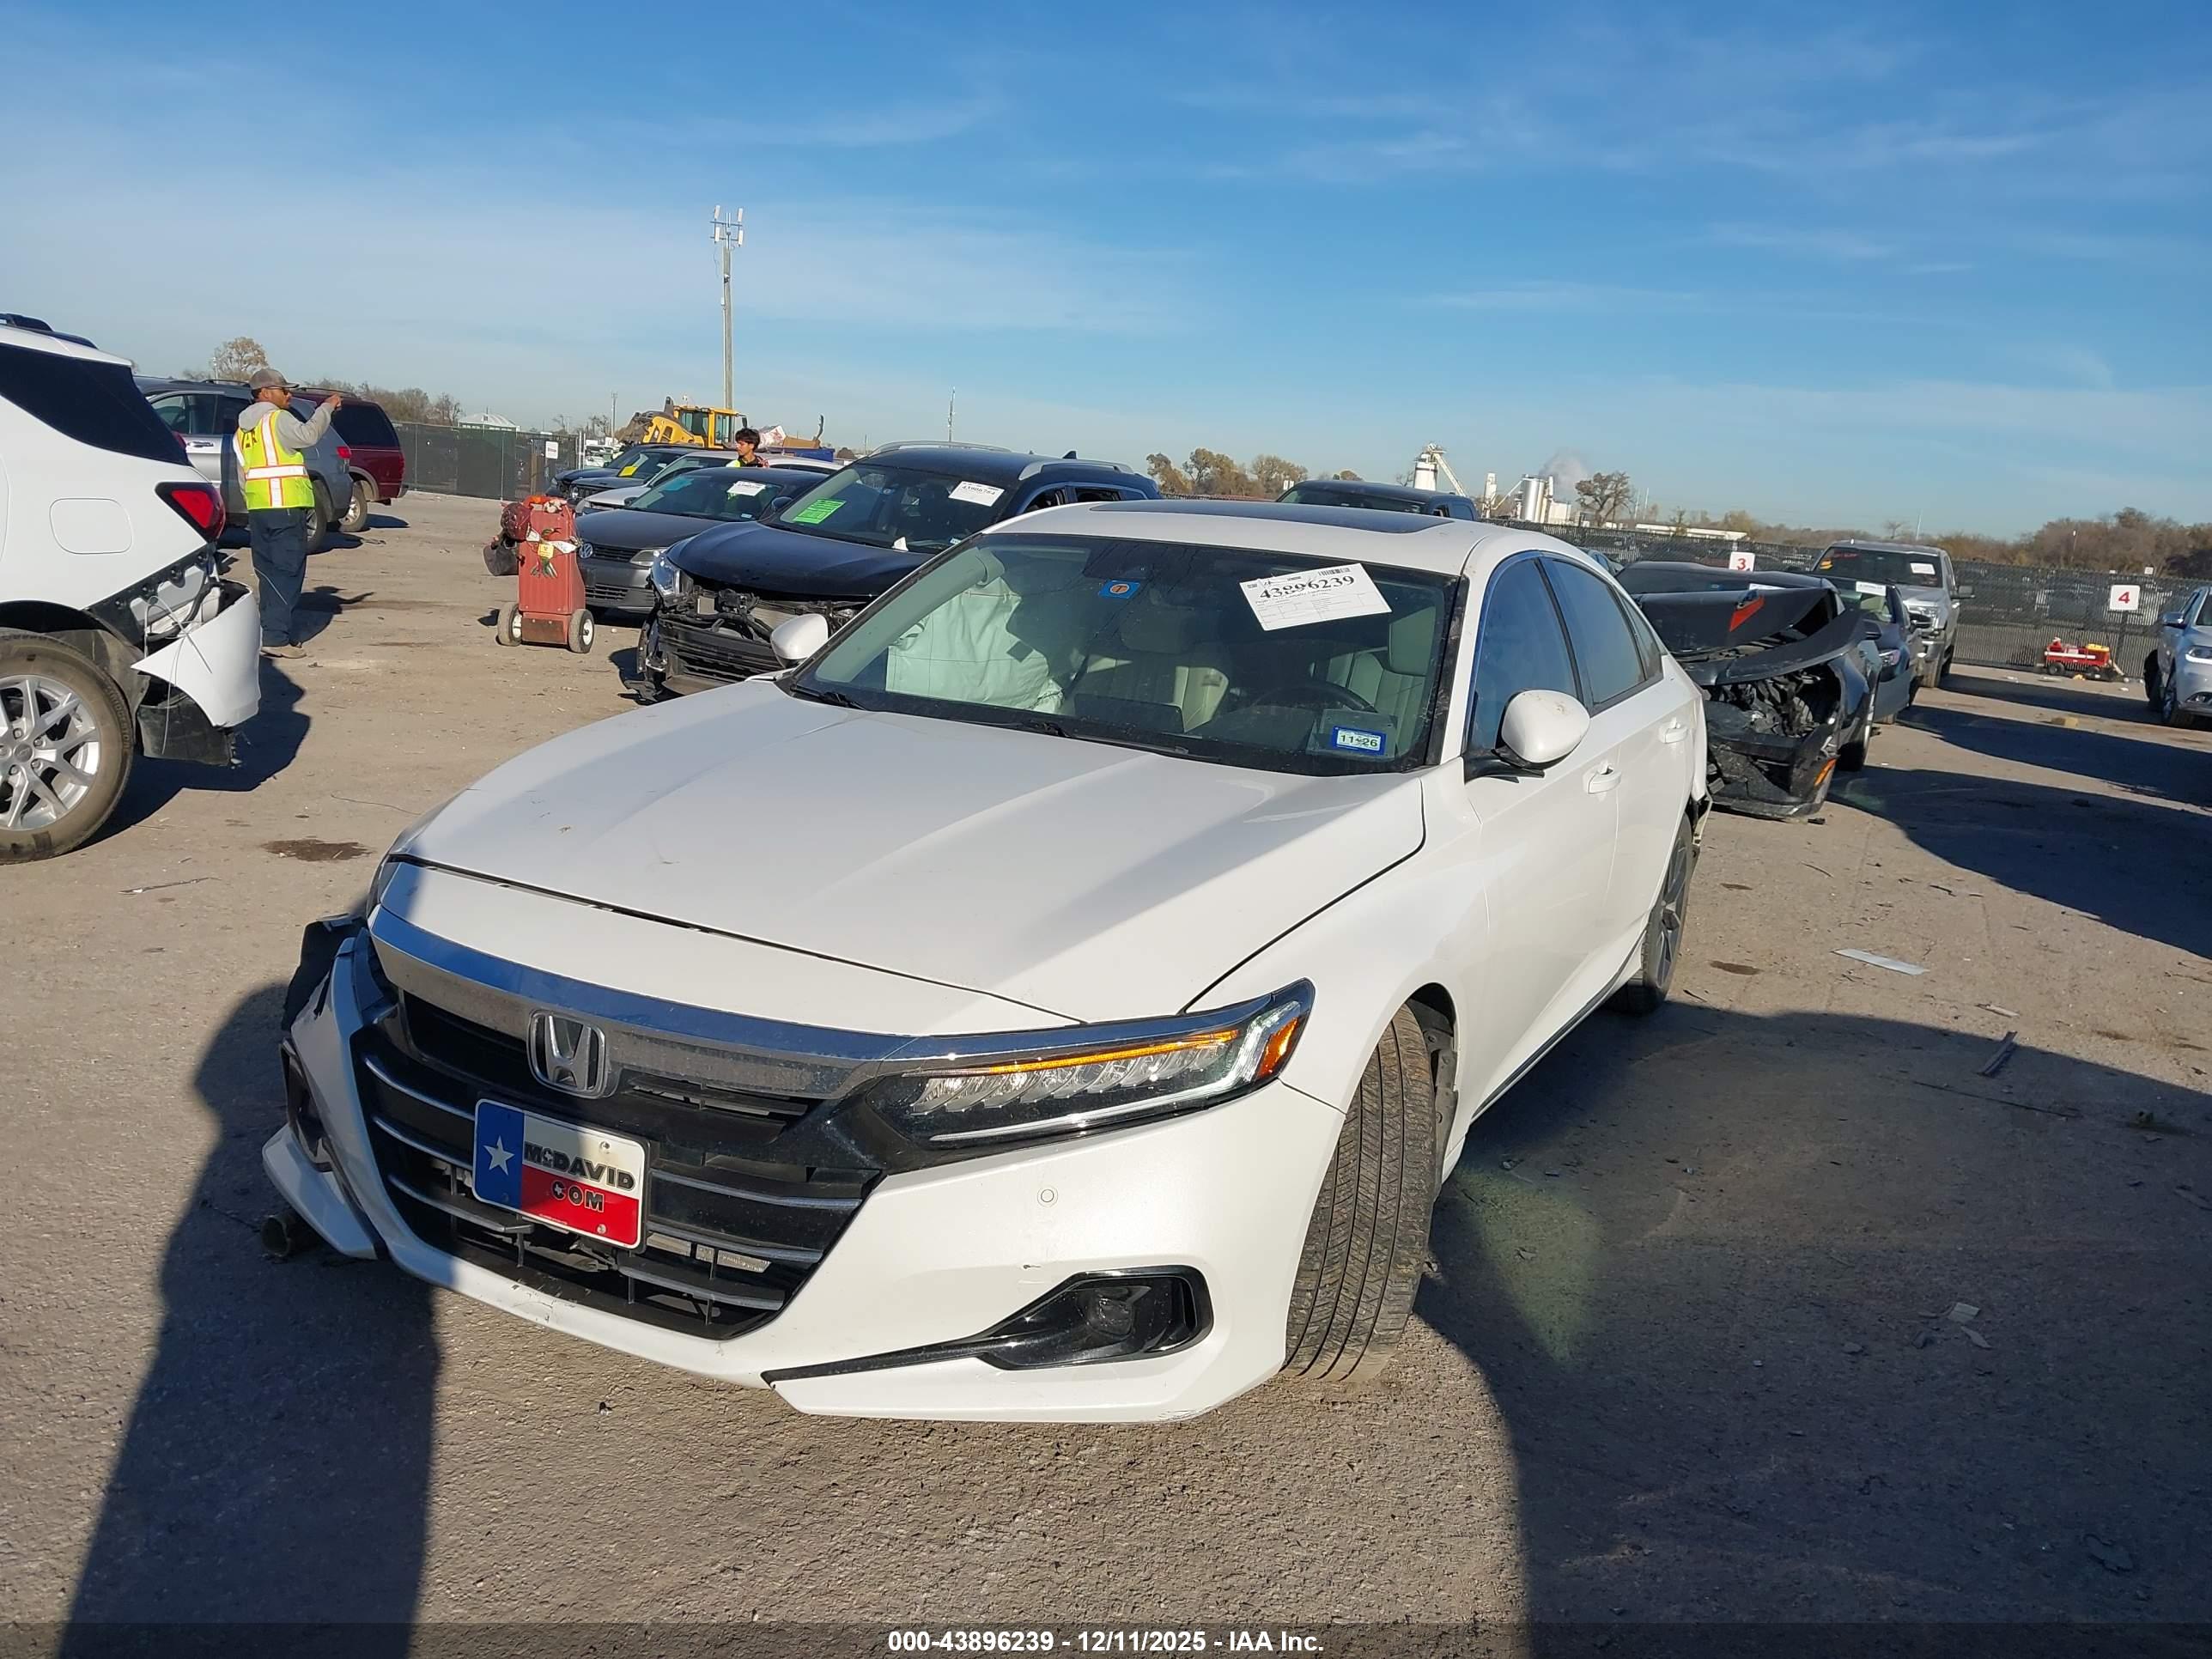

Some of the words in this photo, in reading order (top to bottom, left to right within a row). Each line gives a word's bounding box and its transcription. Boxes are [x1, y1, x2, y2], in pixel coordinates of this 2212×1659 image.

[1736, 558, 1747, 570] 3
[1260, 575, 1355, 599] 43896239
[2118, 591, 2130, 604] 4
